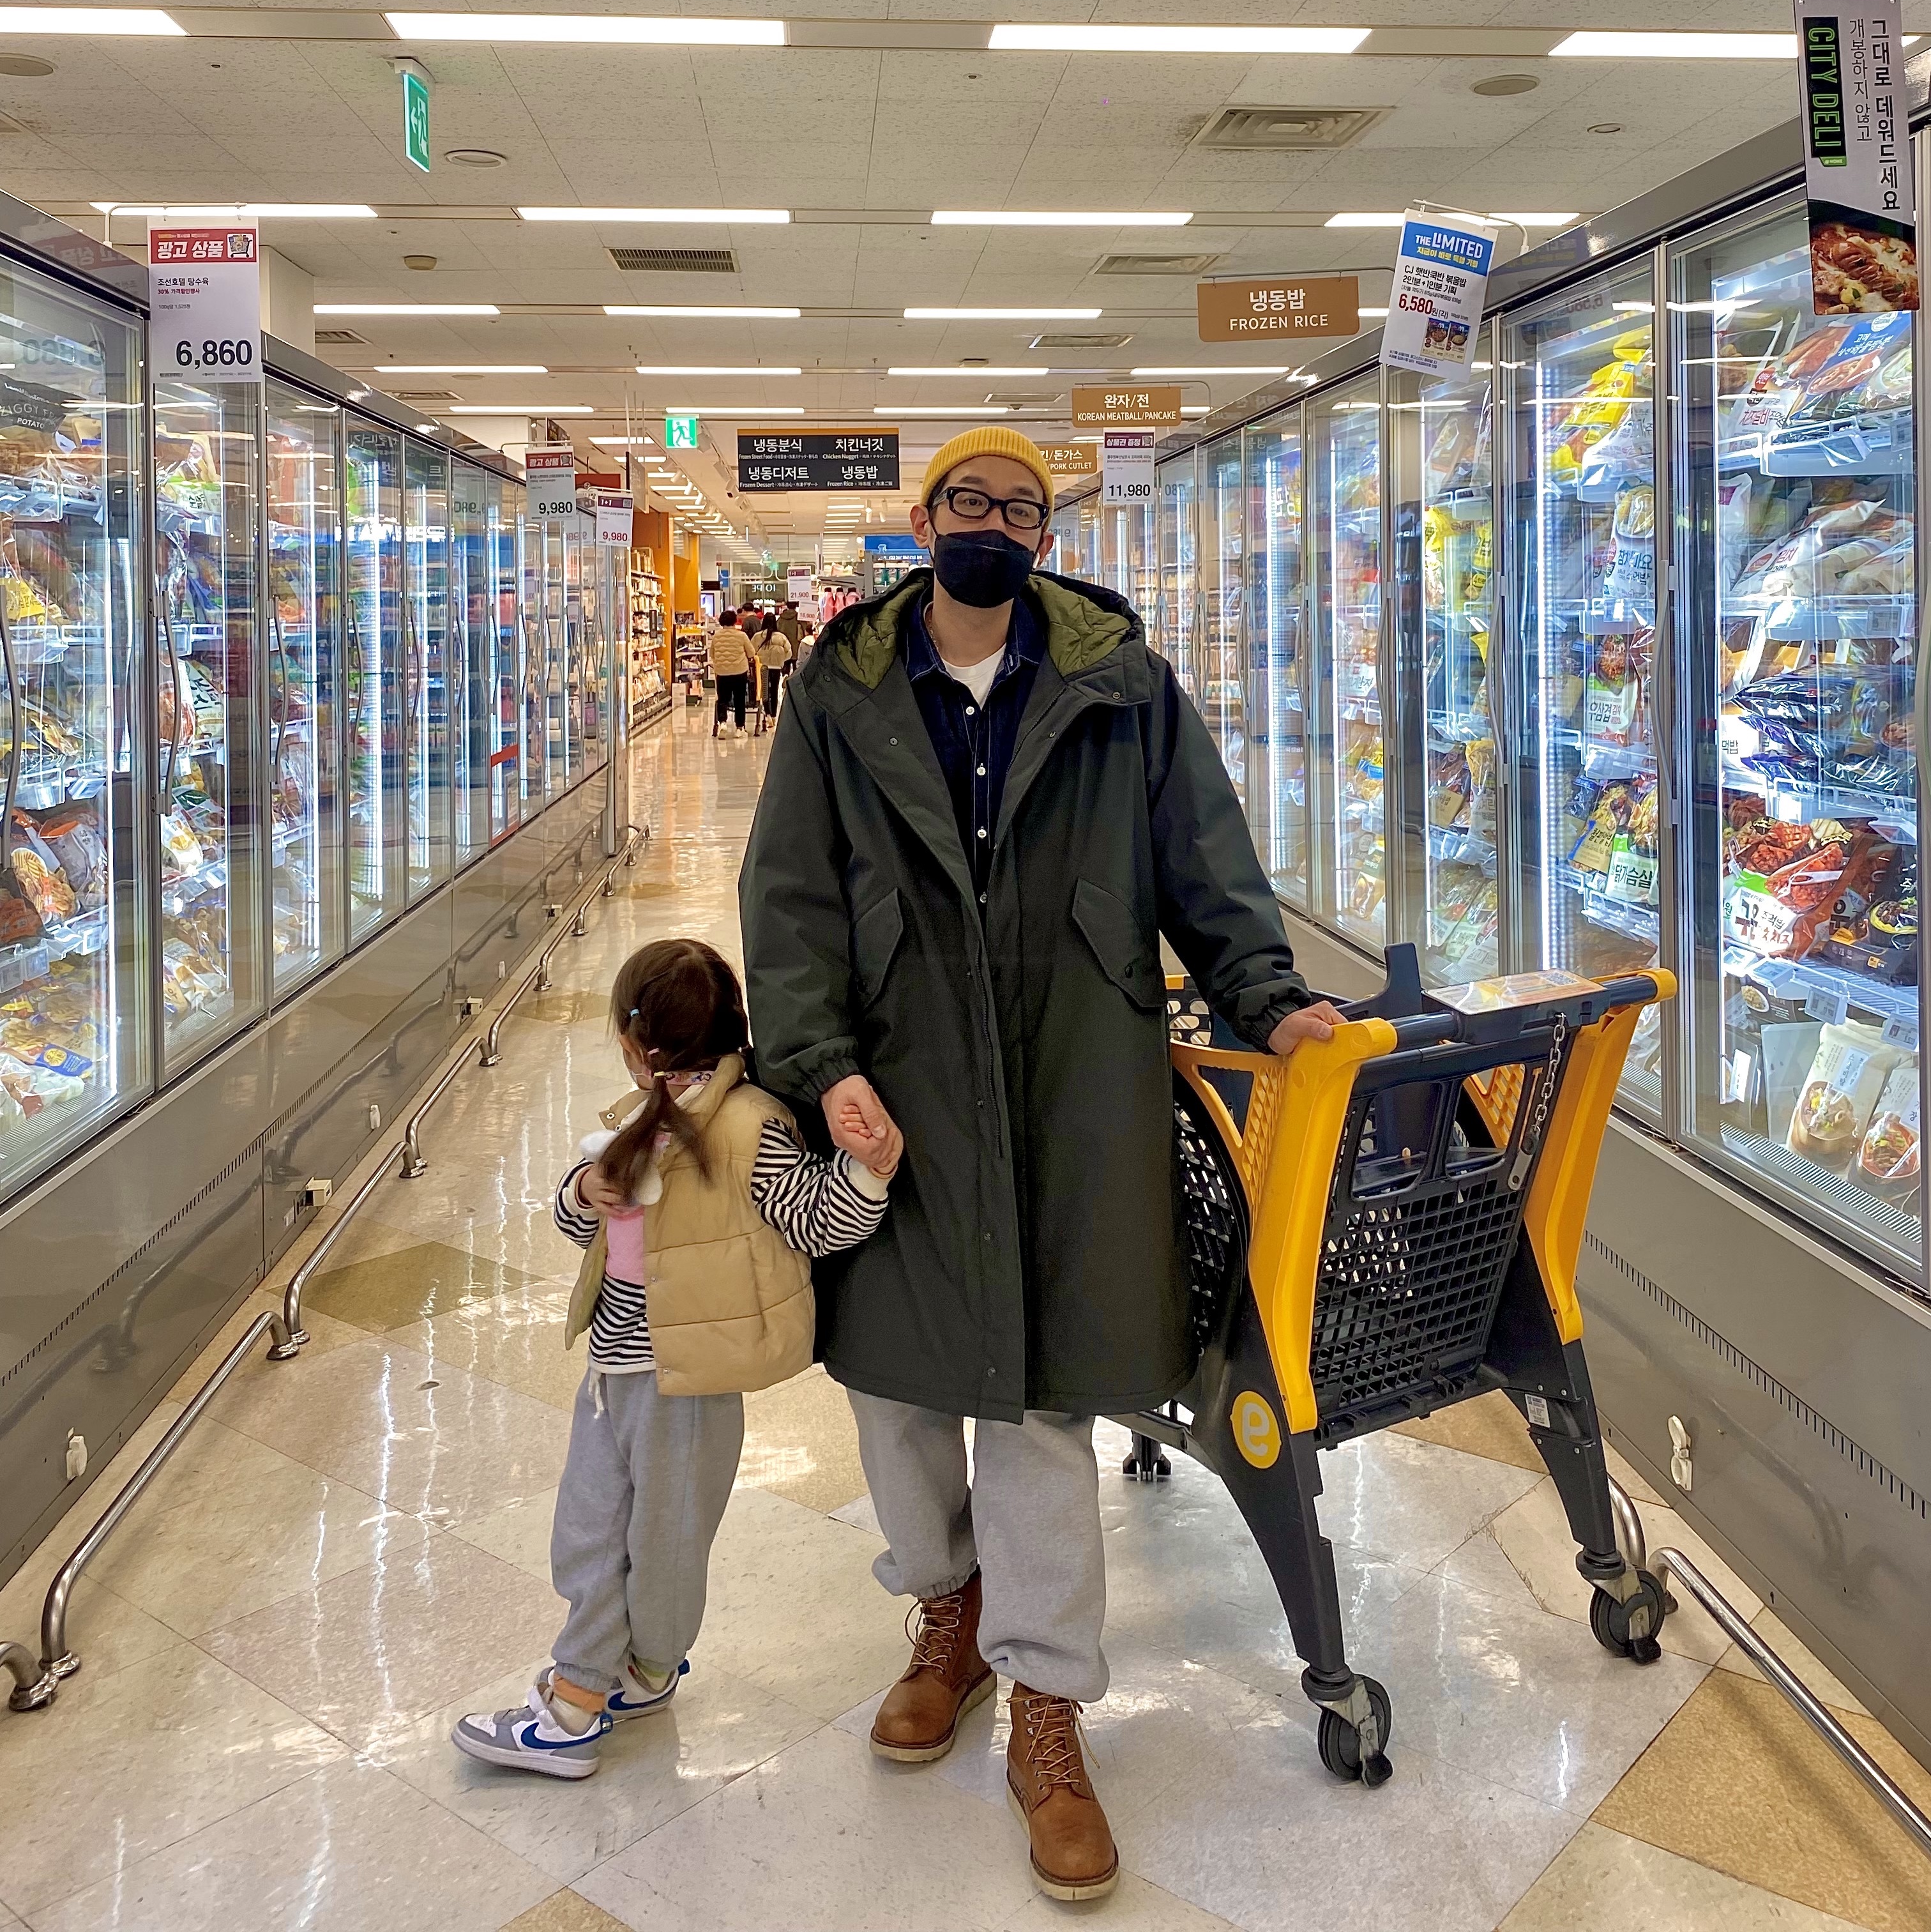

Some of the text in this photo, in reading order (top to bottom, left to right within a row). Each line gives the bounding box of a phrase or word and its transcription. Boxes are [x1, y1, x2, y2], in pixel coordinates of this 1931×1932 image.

[1808, 27, 1842, 147] CITY DELI
[1849, 18, 1872, 141] 개봉하지 않고
[1871, 20, 1900, 211] 그대로 데워드세요
[158, 240, 224, 259] 광고 상품
[1415, 232, 1483, 259] THE LIMITED
[157, 277, 209, 287] 조선호텔 탕수육
[1404, 264, 1467, 288] CJ 햇반쿡반 볶음밥
[1249, 288, 1306, 312] 냉동밥
[1229, 314, 1329, 331] FROZEN RICE
[176, 339, 253, 370] 6,860
[1104, 393, 1149, 409] 완자/전
[17, 417, 45, 429] POTATO
[1077, 411, 1176, 422] KOREAN MEATBALL/PANCAKE
[753, 438, 802, 452] 냉동분식
[835, 437, 884, 452] 치킨너깃
[529, 459, 543, 467] 광고
[748, 466, 810, 481] 냉동디저트
[842, 466, 879, 480] 냉동밥
[1108, 484, 1151, 498] 11,980
[538, 501, 573, 516] 9,980
[602, 531, 628, 542] 9,980
[1614, 863, 1653, 889] 닭가슴살
